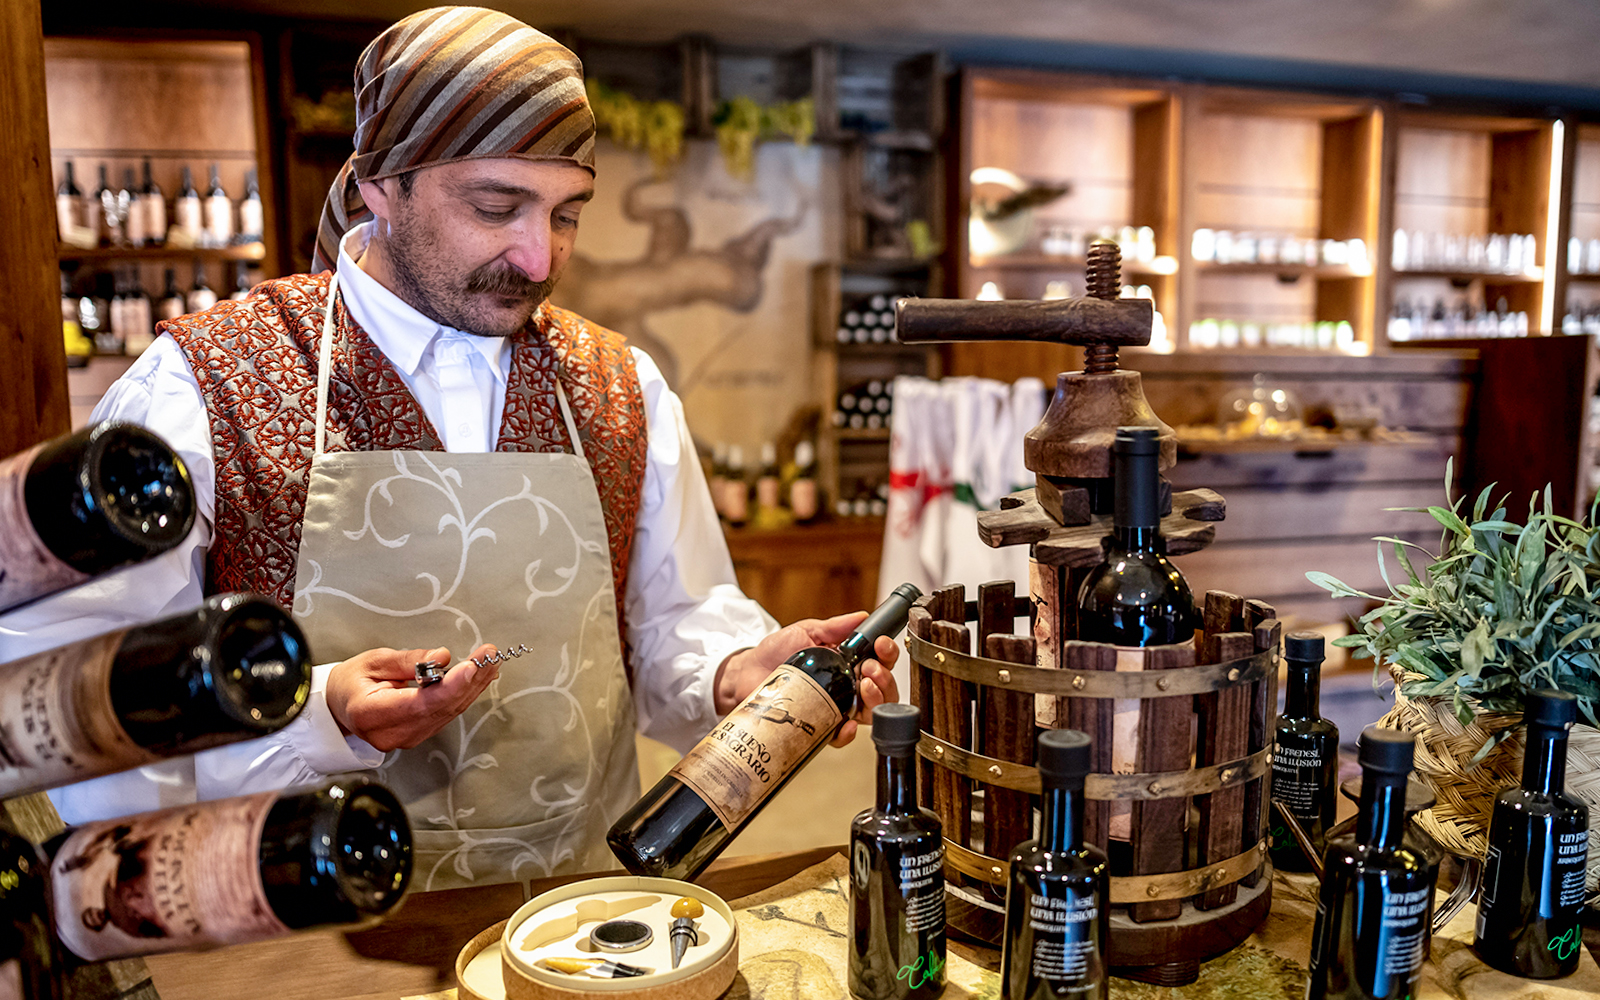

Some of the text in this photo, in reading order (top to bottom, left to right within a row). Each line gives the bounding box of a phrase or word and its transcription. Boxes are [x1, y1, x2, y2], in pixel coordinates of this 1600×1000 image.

[735, 728, 771, 763] SUEÑO
[899, 856, 916, 868] UN
[899, 868, 921, 880] UNA
